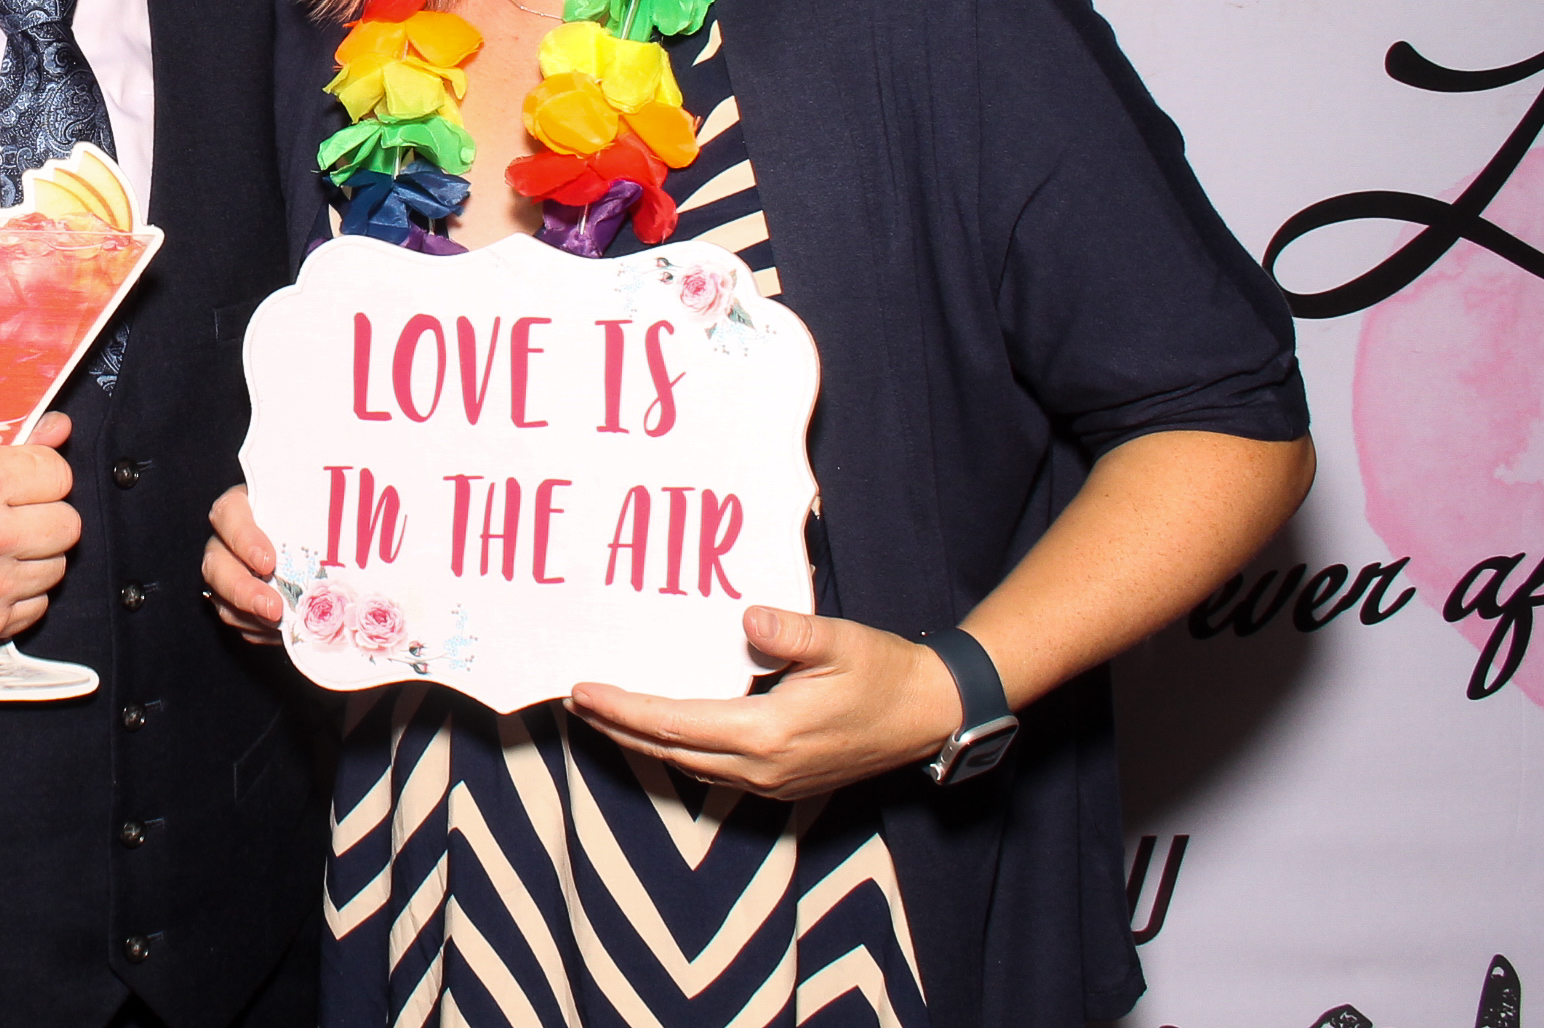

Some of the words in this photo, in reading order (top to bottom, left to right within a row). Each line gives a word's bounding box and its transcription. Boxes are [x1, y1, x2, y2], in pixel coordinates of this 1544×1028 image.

[354, 313, 551, 428] LOVE
[596, 320, 684, 437] IS
[444, 474, 572, 583] THE
[606, 486, 742, 599] AIR
[1189, 556, 1417, 640] ever
